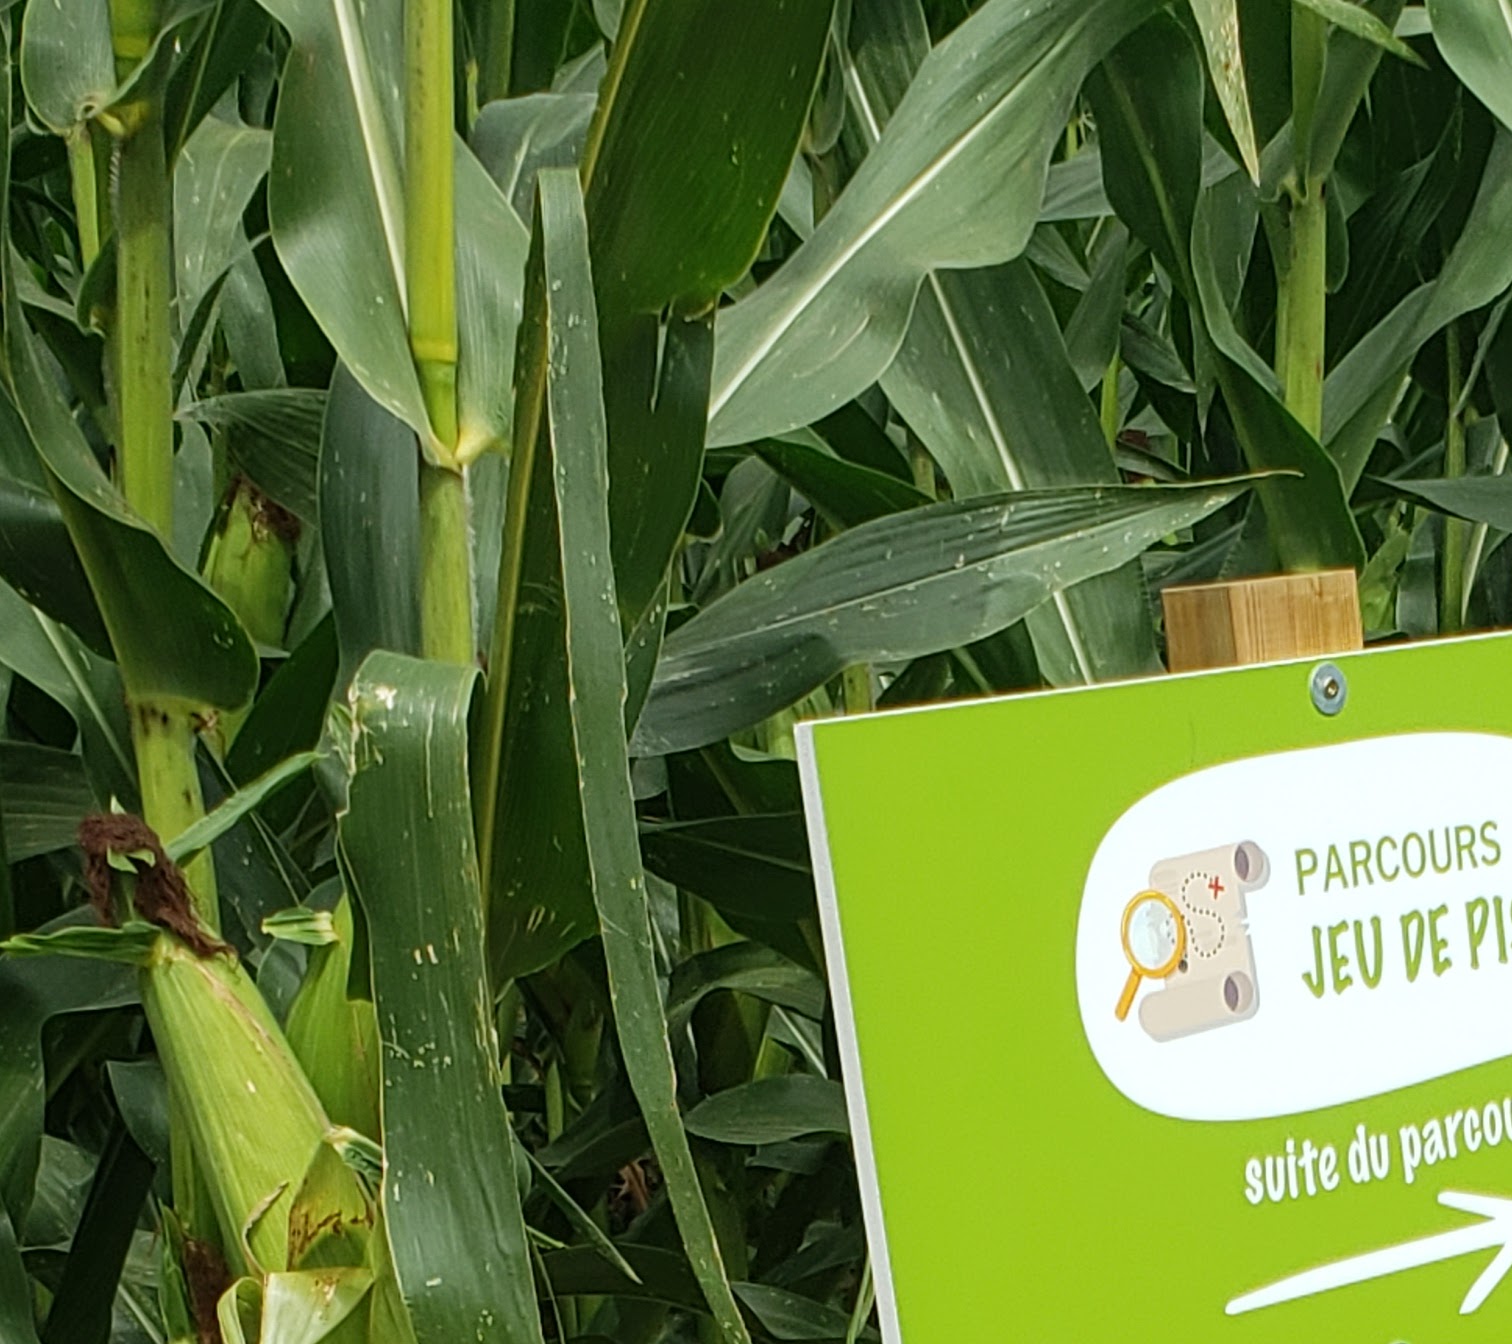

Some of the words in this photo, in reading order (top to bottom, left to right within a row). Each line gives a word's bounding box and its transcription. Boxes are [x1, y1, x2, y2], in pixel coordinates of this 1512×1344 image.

[1294, 820, 1502, 896] PARCOURS
[1302, 914, 1383, 999] JEU
[1400, 904, 1452, 982] DE
[1244, 1137, 1339, 1205] suite
[1348, 1124, 1390, 1184] du
